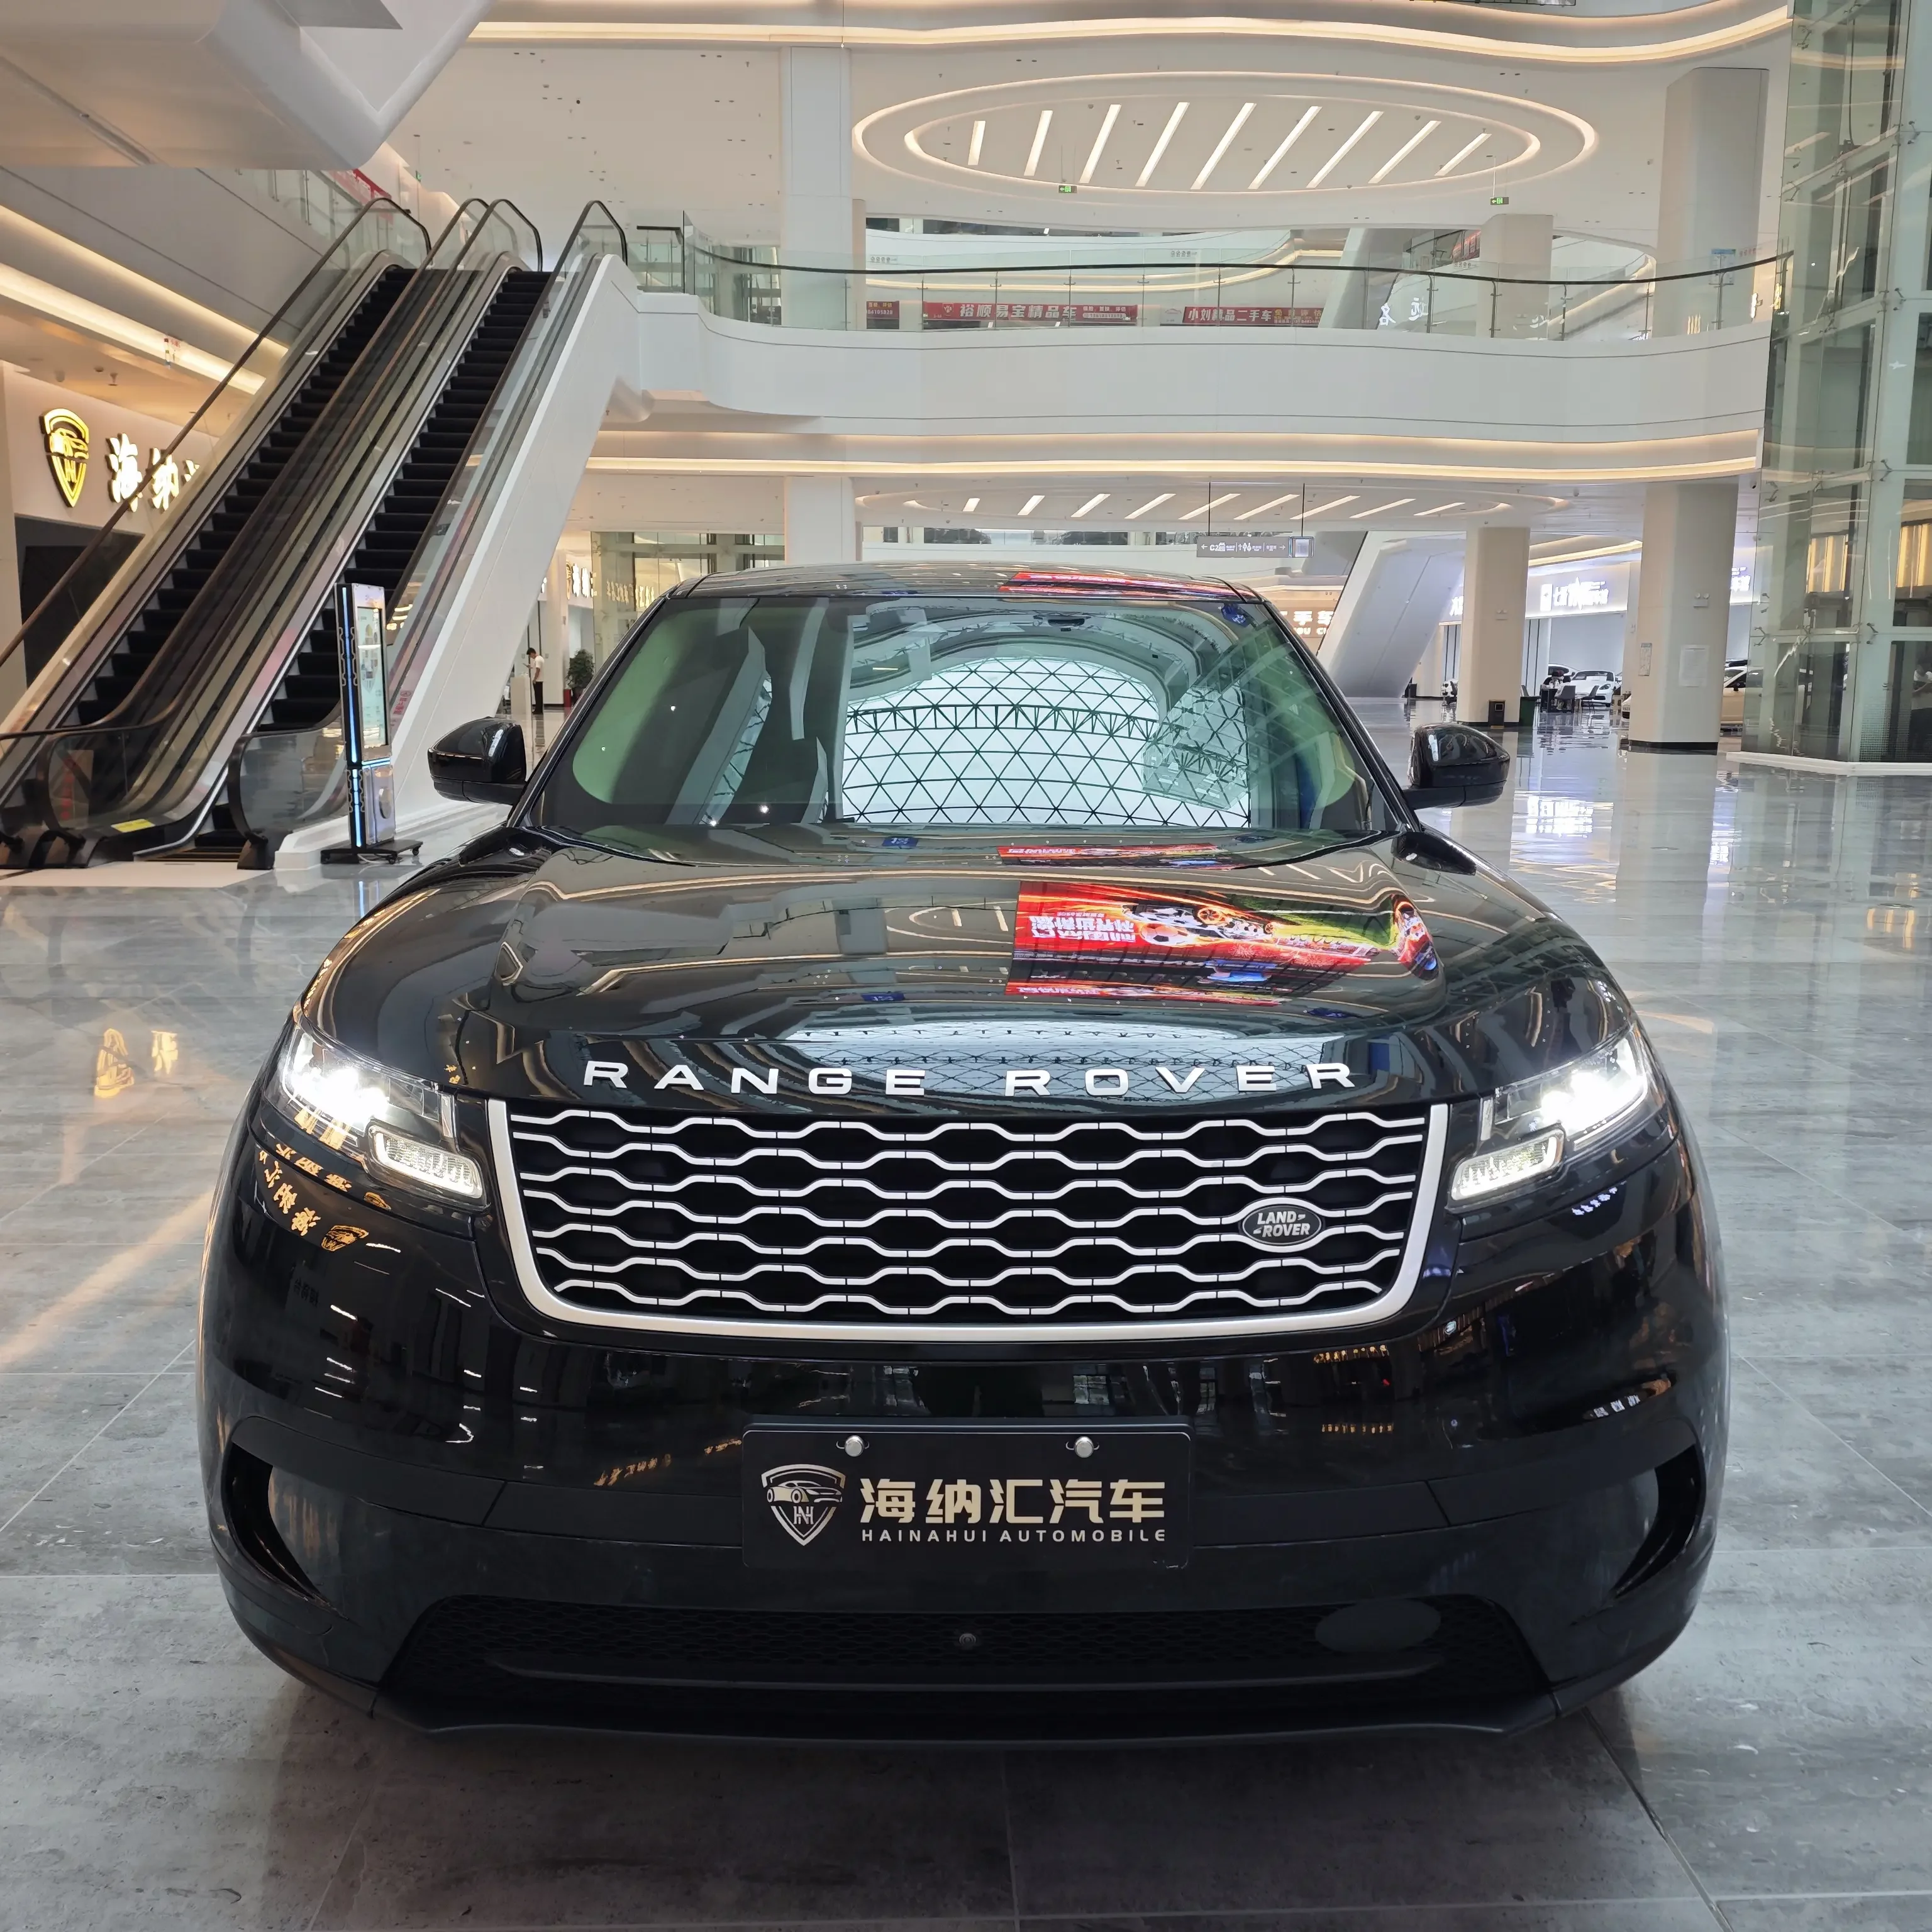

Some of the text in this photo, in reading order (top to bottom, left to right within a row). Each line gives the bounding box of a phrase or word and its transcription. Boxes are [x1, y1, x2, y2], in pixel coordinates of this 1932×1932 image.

[960, 304, 1077, 320] 裕顺易宝精品车
[1187, 308, 1272, 322] 小刘精品二手车
[584, 1061, 1355, 1097] RANGE ROVER
[1257, 1211, 1297, 1224] LAND
[1262, 1223, 1311, 1238] ROVER
[860, 1479, 1165, 1524] 海纳汇汽车
[862, 1530, 1165, 1542] HAINAHUI AUTOMOBILE
